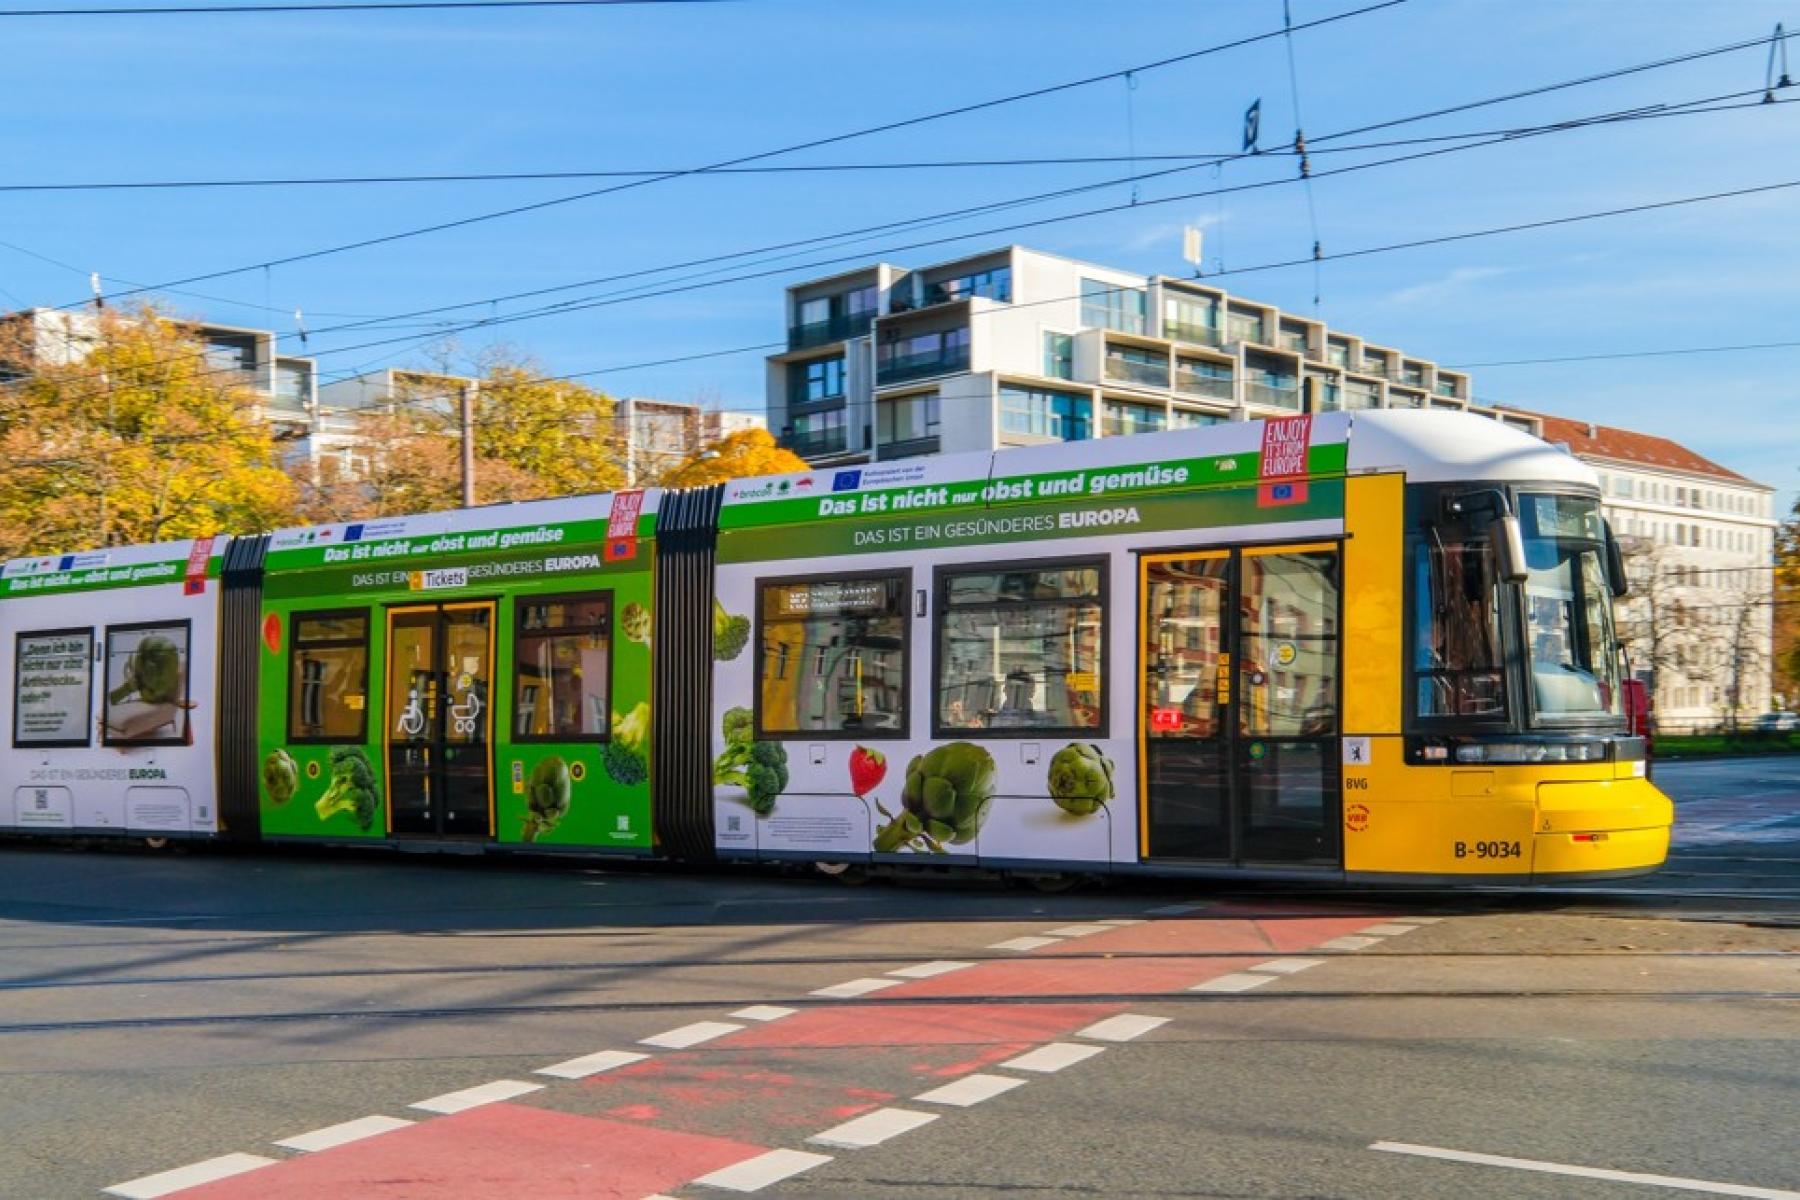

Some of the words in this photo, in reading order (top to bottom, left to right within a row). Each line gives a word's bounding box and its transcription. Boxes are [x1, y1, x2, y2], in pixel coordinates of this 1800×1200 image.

[1266, 419, 1309, 443] ENJOY
[1262, 455, 1304, 477] EUROPE
[818, 497, 857, 517] Das
[861, 493, 889, 513] ist
[892, 488, 948, 509] nicht
[952, 491, 978, 504] nur
[981, 480, 1034, 501] obst
[1038, 473, 1085, 495] und
[1089, 465, 1189, 493] gemüse
[854, 529, 885, 546] DAS
[888, 526, 912, 543] IST
[915, 524, 941, 541] EIN
[944, 515, 1055, 538] GESÜNDERES
[1058, 507, 1141, 529] EUROPA
[324, 548, 351, 563] Das
[352, 544, 371, 559] ist
[372, 541, 410, 557] nicht
[431, 536, 465, 552] obst
[467, 531, 499, 548] und
[499, 526, 564, 548] gemüse
[352, 574, 374, 587] DAS
[375, 572, 390, 585] IST
[544, 554, 601, 572] EUROPA
[425, 569, 465, 587] Tickets
[1346, 778, 1368, 790] BVG
[1454, 841, 1522, 859] B-9034
